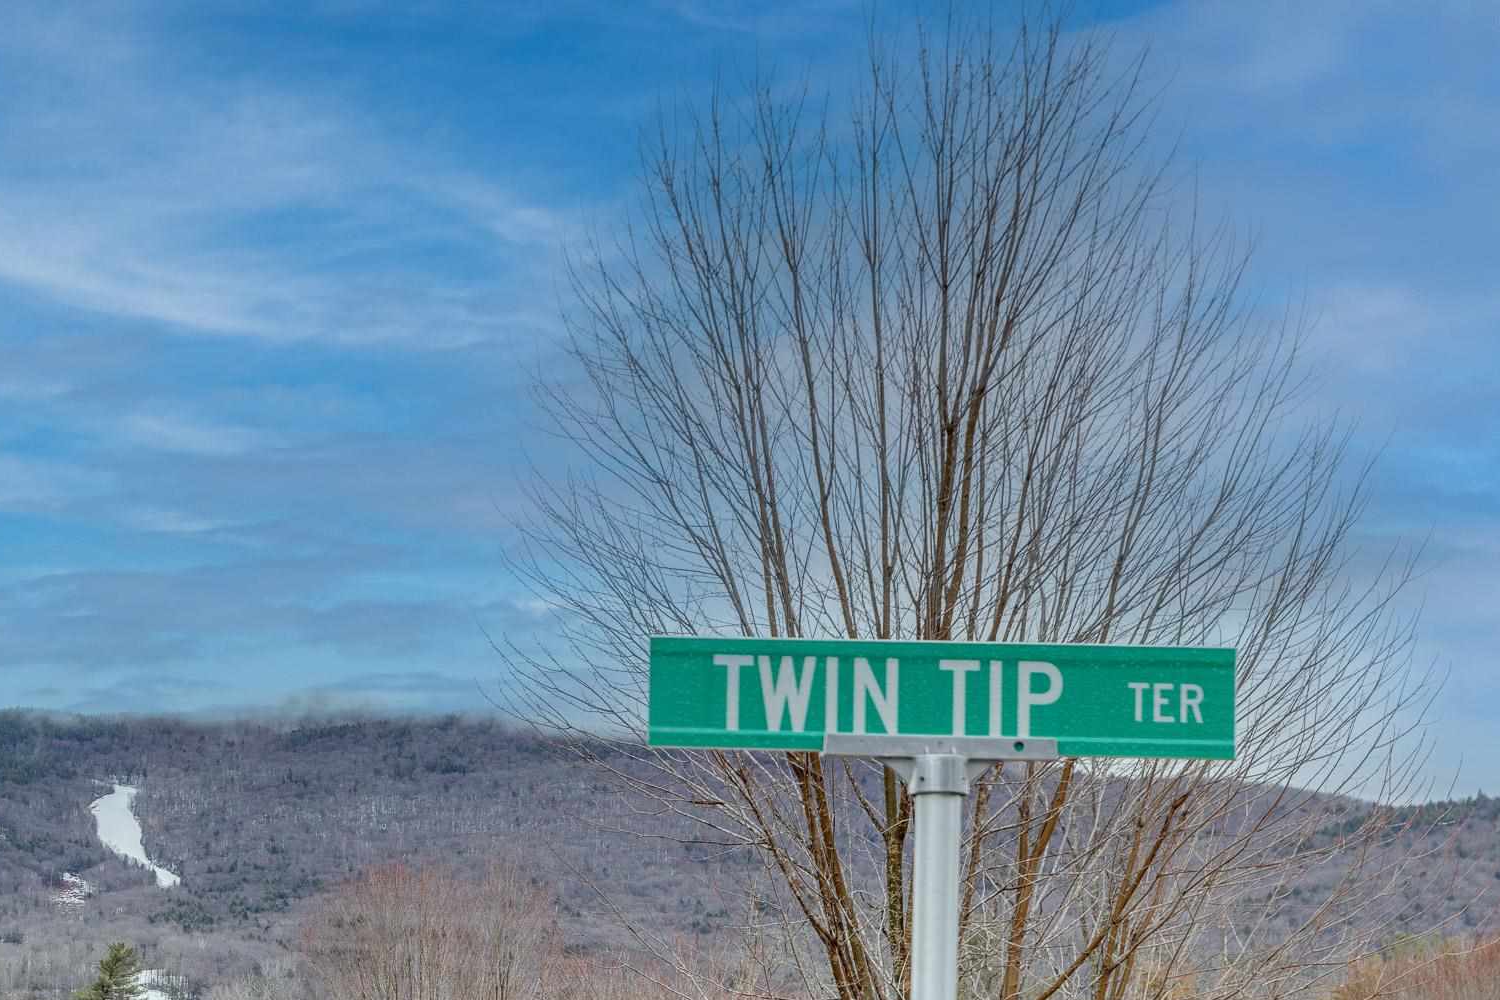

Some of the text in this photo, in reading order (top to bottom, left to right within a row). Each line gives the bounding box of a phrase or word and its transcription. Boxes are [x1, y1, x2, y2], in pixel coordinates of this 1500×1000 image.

[713, 654, 1204, 738] TWIN TIP TER
